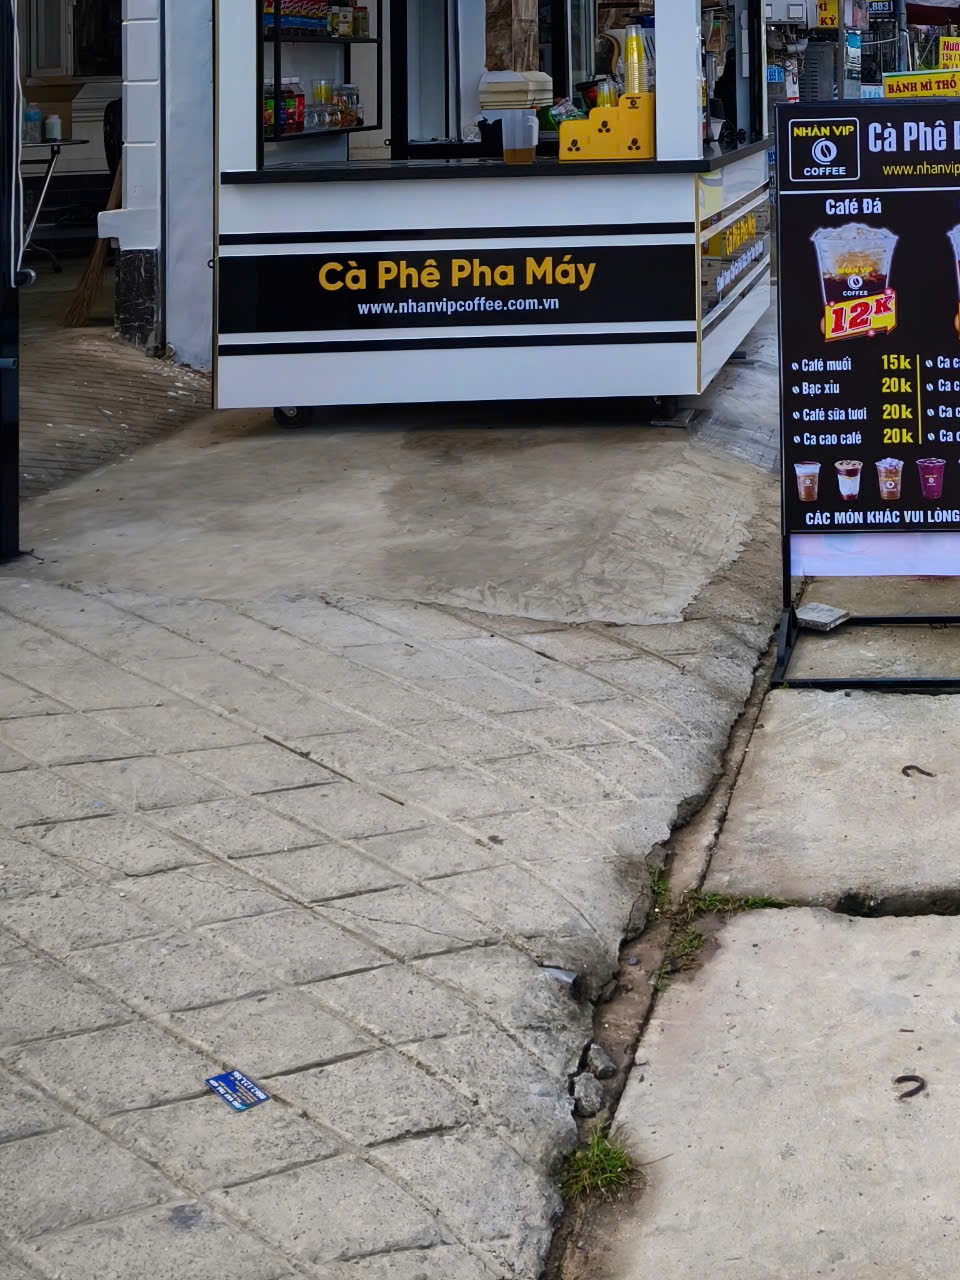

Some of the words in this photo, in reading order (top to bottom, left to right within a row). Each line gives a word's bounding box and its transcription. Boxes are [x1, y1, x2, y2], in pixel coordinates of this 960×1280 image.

[867, 2, 888, 10] .883
[888, 79, 918, 94] BÁNH
[920, 78, 932, 91] MÌ
[935, 73, 957, 89] THỔ
[832, 126, 854, 136] VIP
[868, 121, 897, 152] Cà
[904, 120, 947, 151] Phê
[804, 167, 846, 176] COFFEE
[825, 198, 858, 214] Café
[863, 197, 882, 214] Đá
[318, 261, 366, 291] Cà
[378, 259, 440, 289] Phê
[451, 258, 515, 287] Pha
[526, 254, 596, 292] Máy
[357, 296, 560, 315] www.nhanvipcoffee.com.vn
[801, 358, 824, 371] Café
[827, 355, 852, 371] muối
[937, 355, 950, 368] Ca
[802, 381, 821, 397] Bạc
[938, 379, 951, 391] Ca
[803, 407, 825, 421] Café
[828, 407, 845, 421] sữa
[848, 406, 867, 420] tươi
[938, 405, 952, 417] Ca
[803, 433, 817, 445] Ca
[819, 433, 837, 445] cao
[840, 430, 862, 444] café
[939, 429, 953, 442] Ca
[805, 510, 831, 525] CÁC
[834, 509, 863, 524] MÓN
[867, 508, 900, 524] KHÁC
[904, 510, 924, 523] VUI
[927, 507, 960, 522] LÒNG
